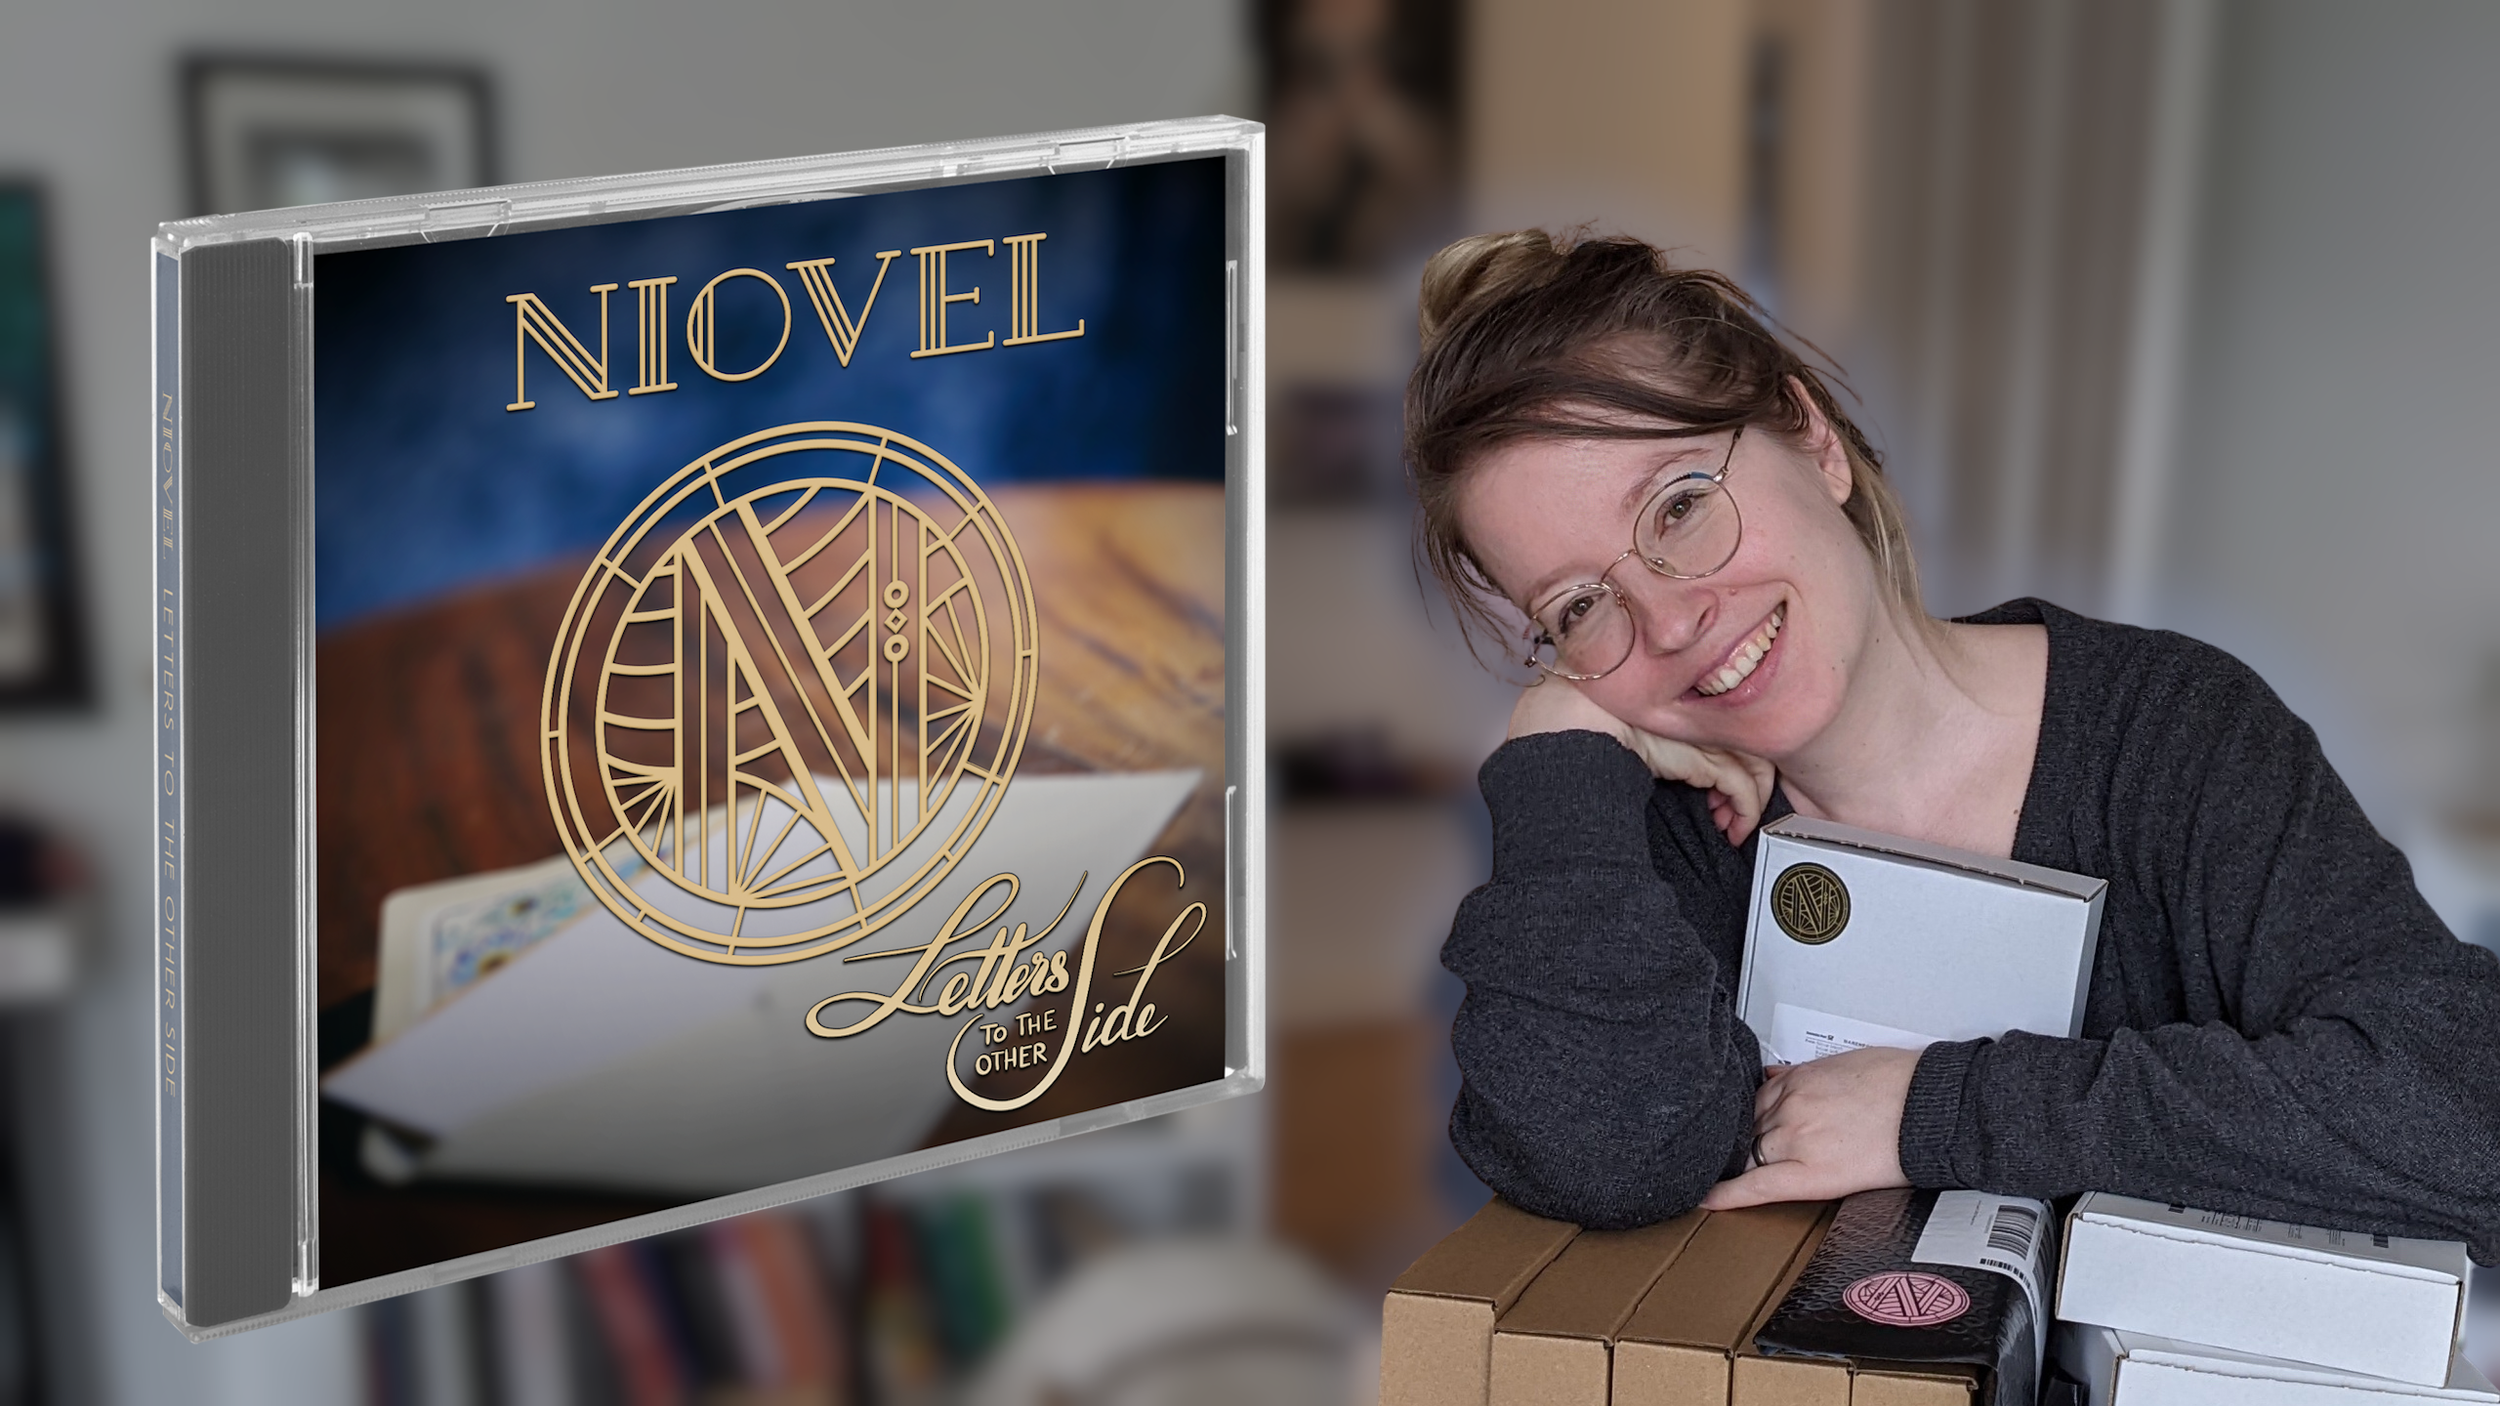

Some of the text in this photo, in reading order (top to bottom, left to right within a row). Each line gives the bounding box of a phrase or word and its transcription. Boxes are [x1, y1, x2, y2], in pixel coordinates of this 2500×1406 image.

[506, 232, 1086, 411] NIOVEL
[162, 390, 176, 1097] NIOVEL LETTERS TO THE OTHER SIDE
[805, 870, 1088, 1038] Letters
[946, 855, 1207, 1111] Side
[1015, 1010, 1058, 1037] THE
[975, 1042, 1048, 1076] OTHER
